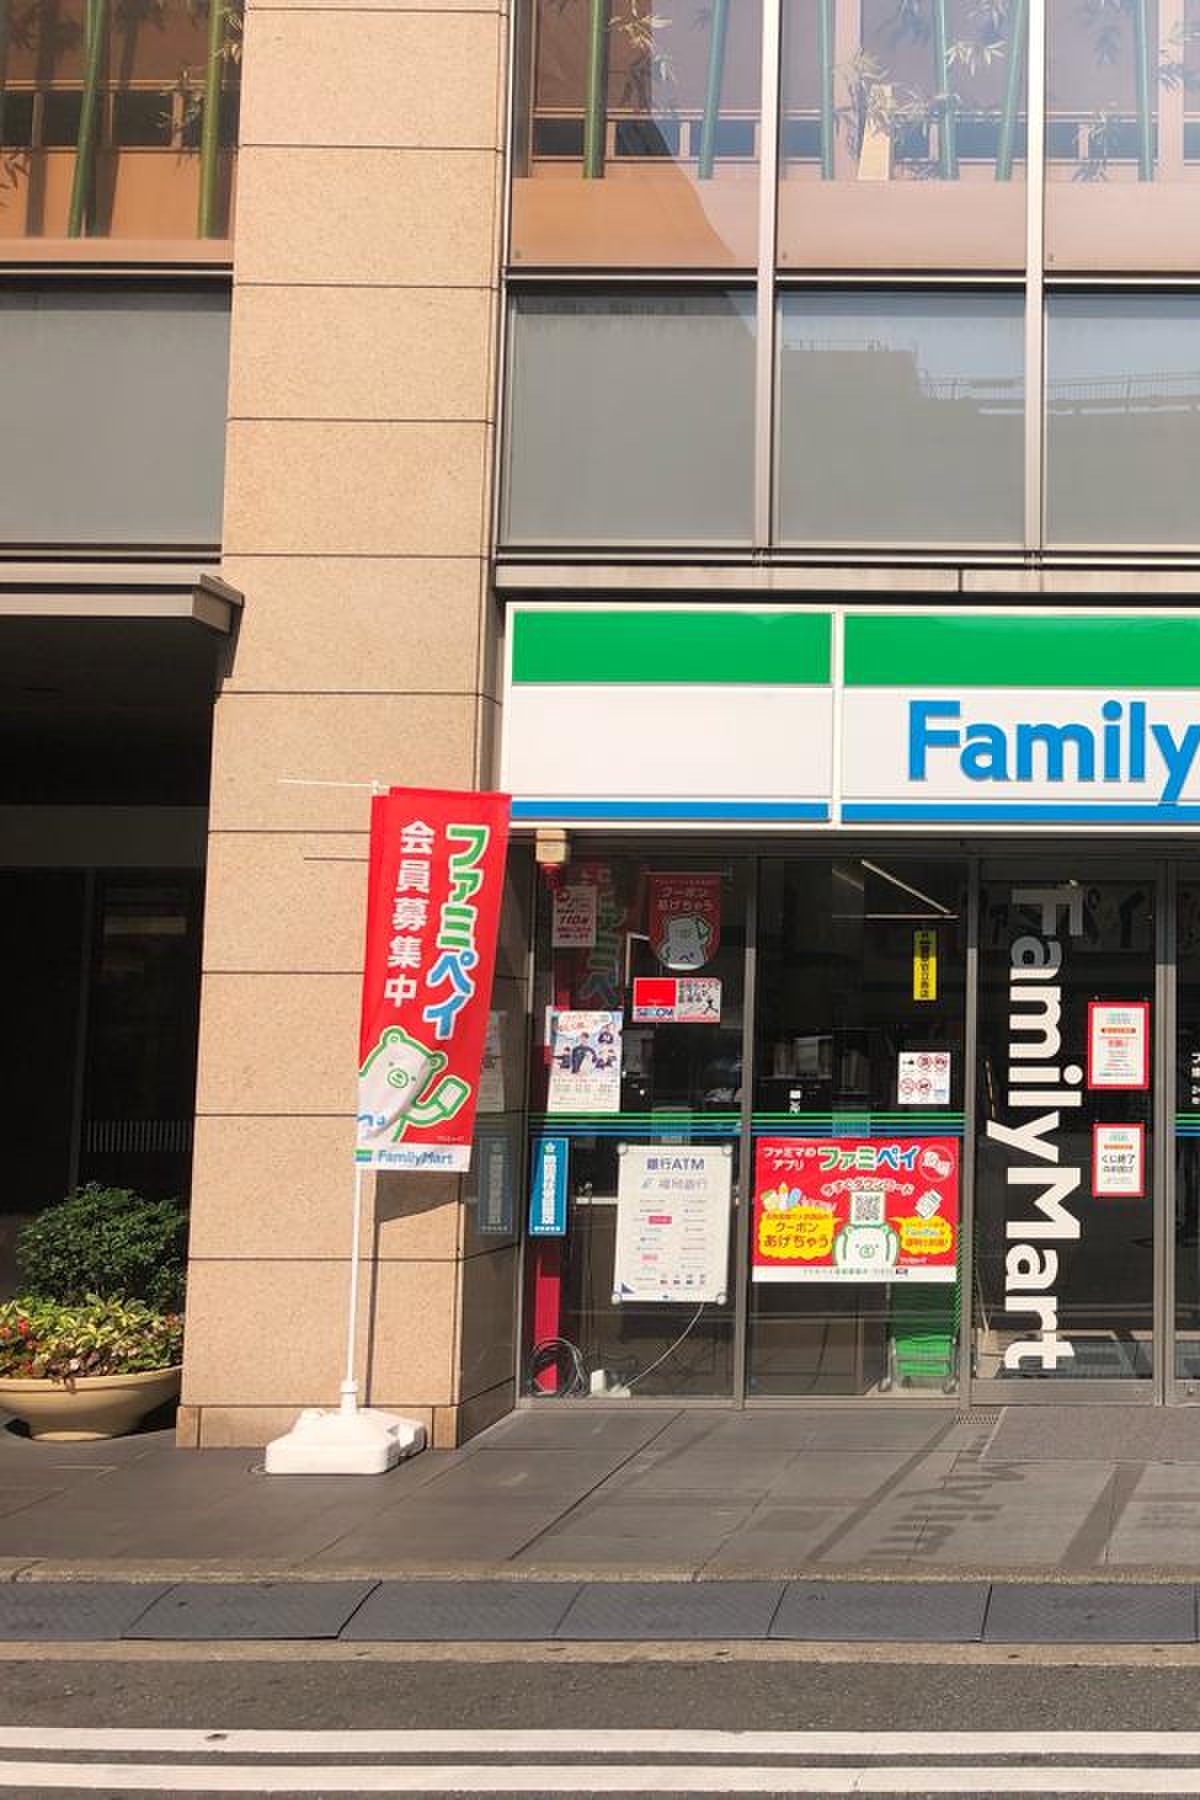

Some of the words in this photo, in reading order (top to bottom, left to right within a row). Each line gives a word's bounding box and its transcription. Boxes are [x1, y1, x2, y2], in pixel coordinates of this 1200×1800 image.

[384, 821, 434, 1007] 会員募集中
[423, 824, 490, 1040] ファミペイ
[987, 889, 1083, 1369] FamilyMart
[376, 1149, 454, 1167] FamilyMart
[646, 1158, 705, 1170] 銀行ATM
[762, 1147, 817, 1159] ファミマの
[817, 1145, 921, 1172] ファミペイ
[772, 1160, 805, 1172] アプリ
[775, 1222, 819, 1233] クーポン
[763, 1235, 830, 1250] あげちゃう
